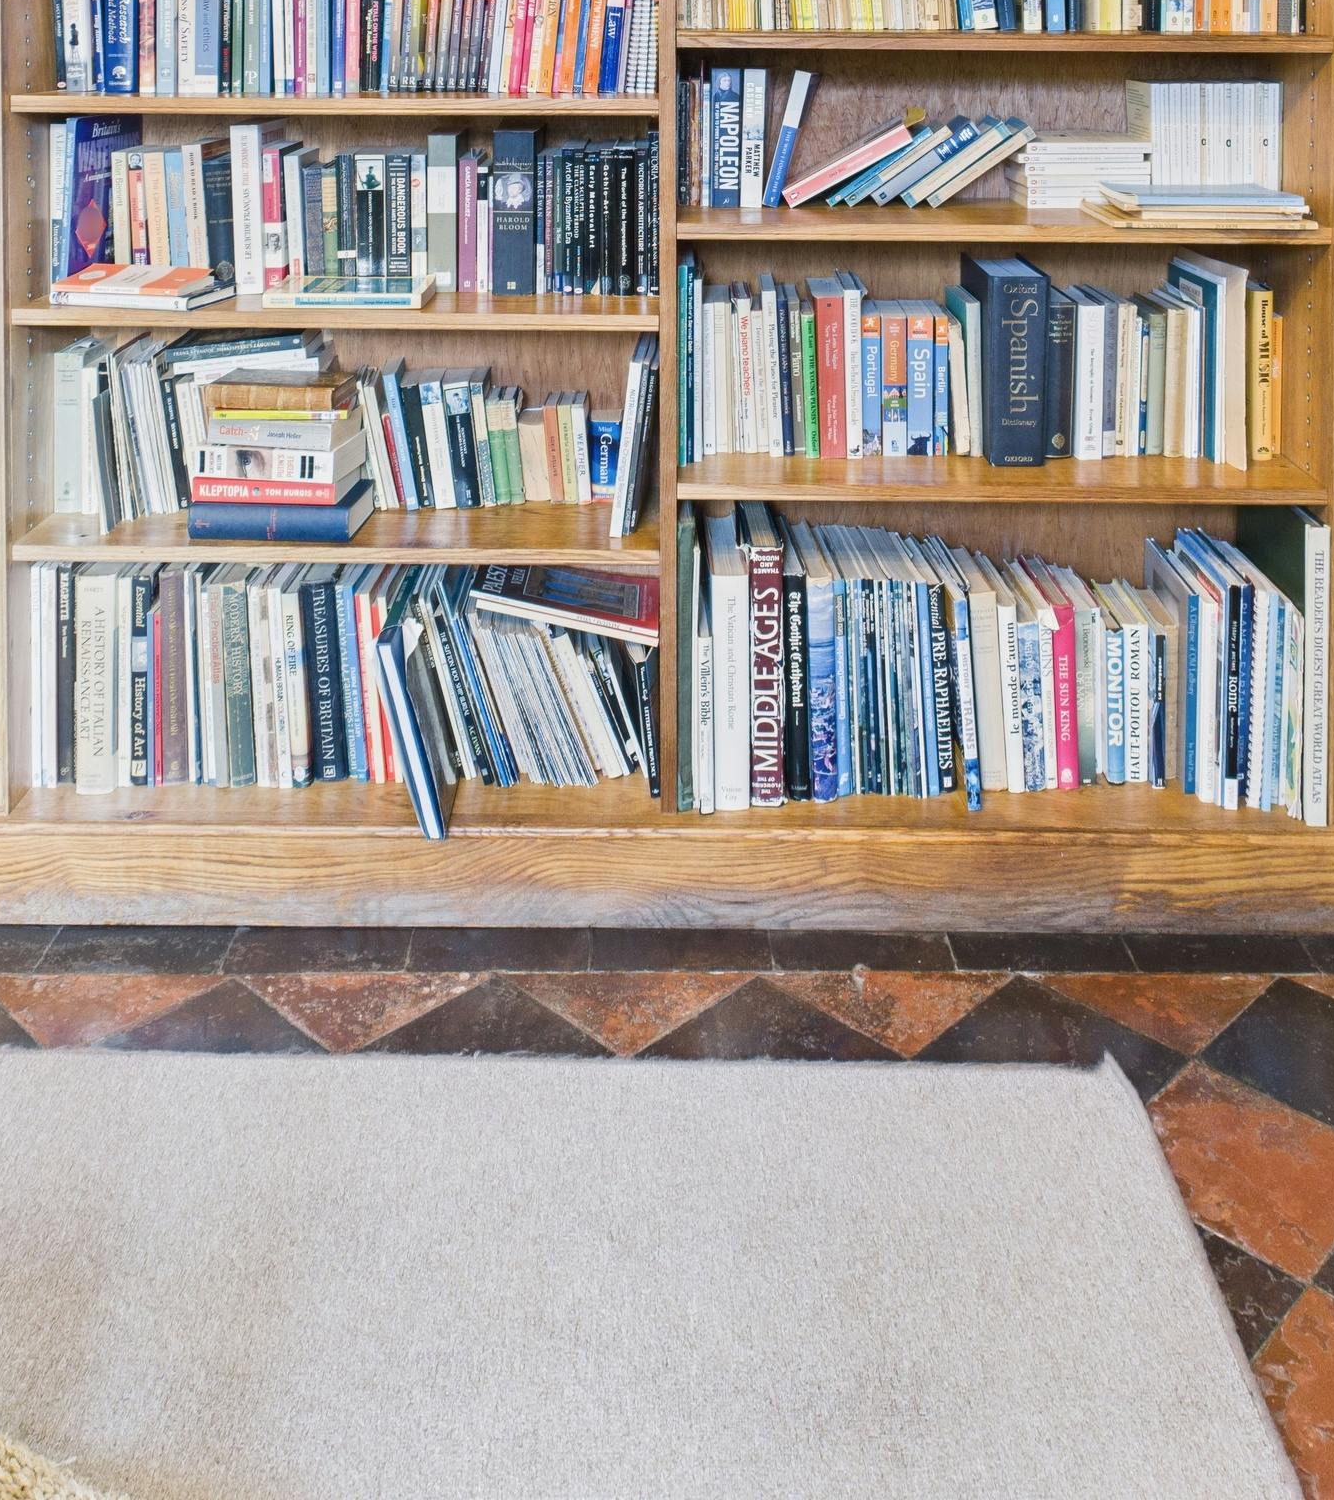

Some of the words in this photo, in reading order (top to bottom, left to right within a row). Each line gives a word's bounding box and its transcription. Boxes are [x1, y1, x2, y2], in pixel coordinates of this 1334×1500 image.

[107, 9, 117, 44] Methods
[179, 13, 190, 25] of
[201, 13, 210, 25] and
[180, 27, 191, 63] SAFETY
[201, 27, 212, 52] ethics
[719, 102, 739, 190] NAPOLEON
[745, 147, 754, 174] PARKER
[752, 143, 761, 177] MATTHEW
[397, 178, 406, 229] DANGEROUS
[397, 231, 406, 254] BOOK
[1003, 284, 1038, 294] Oxford
[740, 315, 749, 330] We
[1260, 299, 1269, 328] House
[738, 331, 751, 356] piano
[1260, 330, 1269, 339] of
[865, 345, 878, 398] Portugal
[887, 340, 900, 382] Germany
[911, 348, 929, 398] Spain
[1001, 299, 1039, 414] Spanish
[1258, 340, 1270, 388] MUSIC
[741, 357, 752, 396] teachers
[937, 366, 946, 393] Berlin
[1001, 418, 1037, 426] Dictionary
[576, 433, 586, 476] WEATHER
[598, 433, 612, 484] German
[198, 484, 249, 498] KLEPTOPIA
[265, 488, 281, 498] TOM
[1314, 550, 1325, 574] THE
[95, 606, 105, 617] A
[135, 586, 145, 628] Essential
[727, 597, 737, 613] The
[788, 592, 802, 612] The
[1314, 578, 1324, 633] READER'S
[312, 586, 327, 672] TREASURES
[727, 615, 737, 645] Vatican
[753, 587, 779, 660] AGES
[788, 614, 804, 651] Gothic
[92, 618, 105, 676] HISTORY
[727, 648, 737, 663] and
[1130, 629, 1140, 680] ROMAN
[1314, 637, 1324, 677] DIGEST
[80, 620, 91, 716] RENAISSANCE
[232, 646, 243, 695] HISTORY
[727, 665, 737, 702] Christian
[789, 653, 805, 708] Cathedral
[1058, 655, 1068, 680] THE
[93, 680, 104, 700] OF
[132, 677, 145, 719] History
[317, 679, 331, 698] OF
[931, 632, 954, 770] PRE-RAPHAELITES
[1059, 683, 1069, 707] SUN
[1107, 637, 1121, 746] MONITOR
[1313, 681, 1324, 718] GREAT
[80, 718, 90, 741] ART
[92, 703, 105, 757] ITALIAN
[134, 722, 145, 732] of
[318, 702, 334, 760] BRITAIN
[727, 705, 737, 730] Rome
[753, 661, 779, 771] MIDDLE
[1060, 710, 1071, 741] KING
[1129, 687, 1140, 780] HAUT-POITOU
[133, 736, 145, 757] Art
[1312, 722, 1323, 764] WORLD
[1311, 767, 1323, 803] ATLAS
